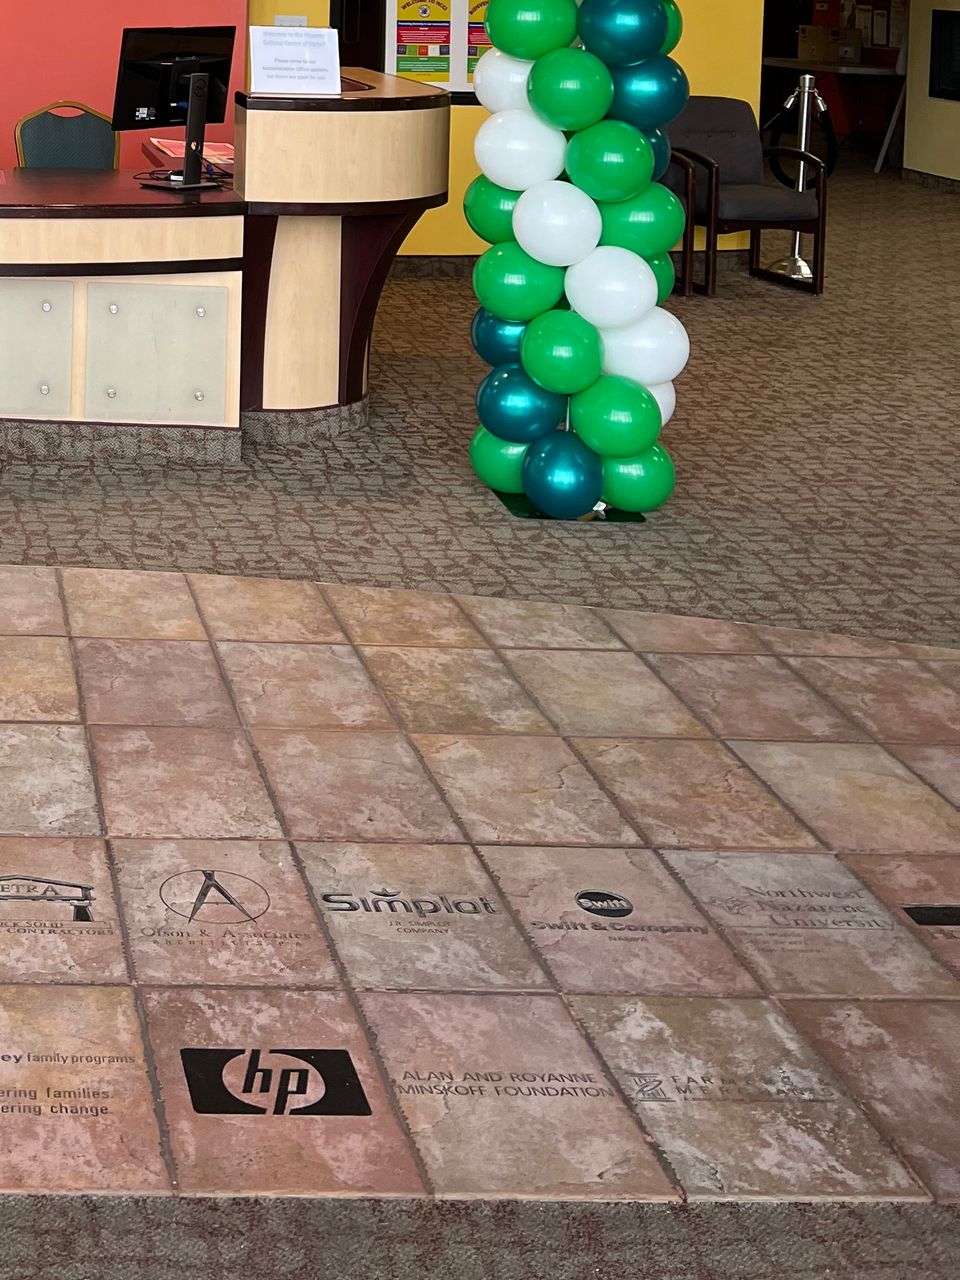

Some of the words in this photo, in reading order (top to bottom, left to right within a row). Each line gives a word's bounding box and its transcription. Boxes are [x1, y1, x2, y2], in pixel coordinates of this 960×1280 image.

[740, 886, 865, 898] Northwest
[322, 890, 498, 918] Simplot
[578, 898, 628, 909] Swift
[754, 900, 867, 912] Nazarene
[531, 921, 588, 931] Swift
[591, 922, 608, 931] &
[609, 922, 708, 934] Company
[768, 914, 894, 930] University
[140, 928, 190, 937] Olson
[200, 929, 210, 937] &
[27, 1052, 69, 1064] family
[71, 1054, 136, 1064] programs
[242, 1049, 309, 1115] hp
[402, 1071, 454, 1082] ALAN
[462, 1072, 503, 1082] AND
[510, 1073, 598, 1084] ROYANNE
[398, 1085, 488, 1095] MINSKOFF
[494, 1085, 615, 1098] FOUNDATION
